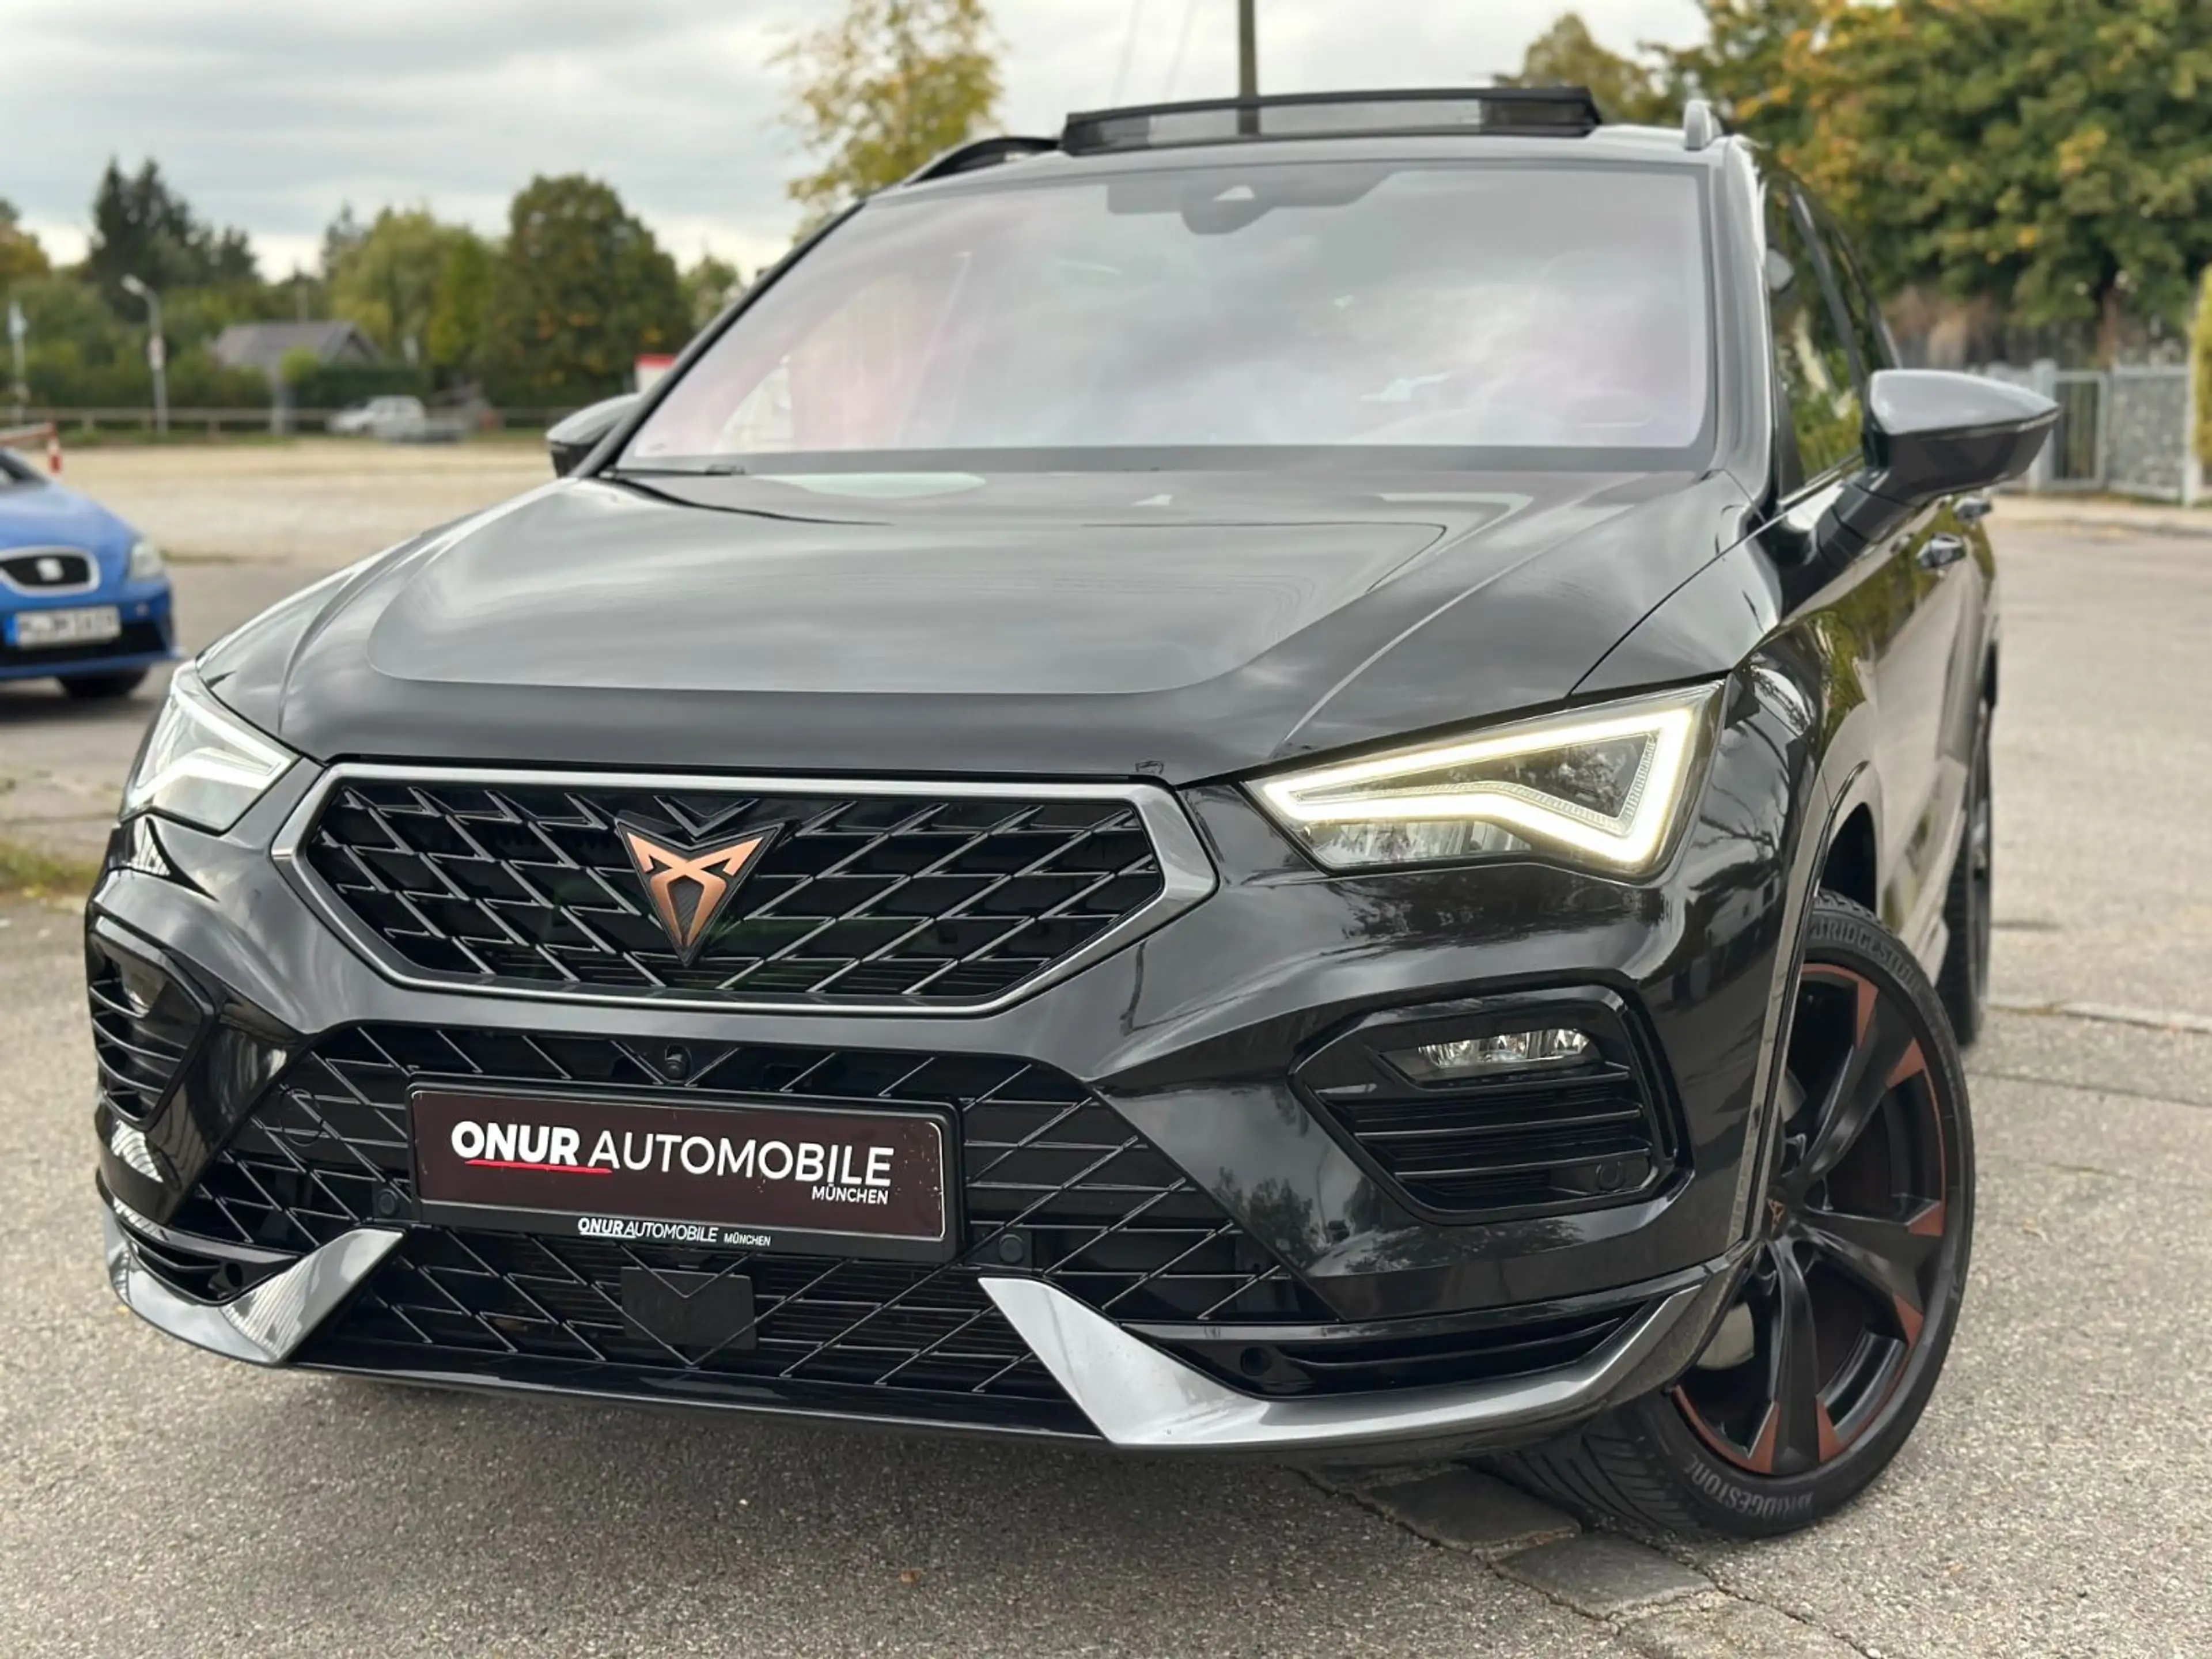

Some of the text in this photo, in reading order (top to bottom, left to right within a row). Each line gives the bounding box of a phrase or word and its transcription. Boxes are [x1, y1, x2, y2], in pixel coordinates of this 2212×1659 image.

[451, 1120, 894, 1187] ONUR AUTOMOBILE
[811, 1183, 889, 1205] MÜNCHEN
[724, 1232, 771, 1247] MÜNCHEN
